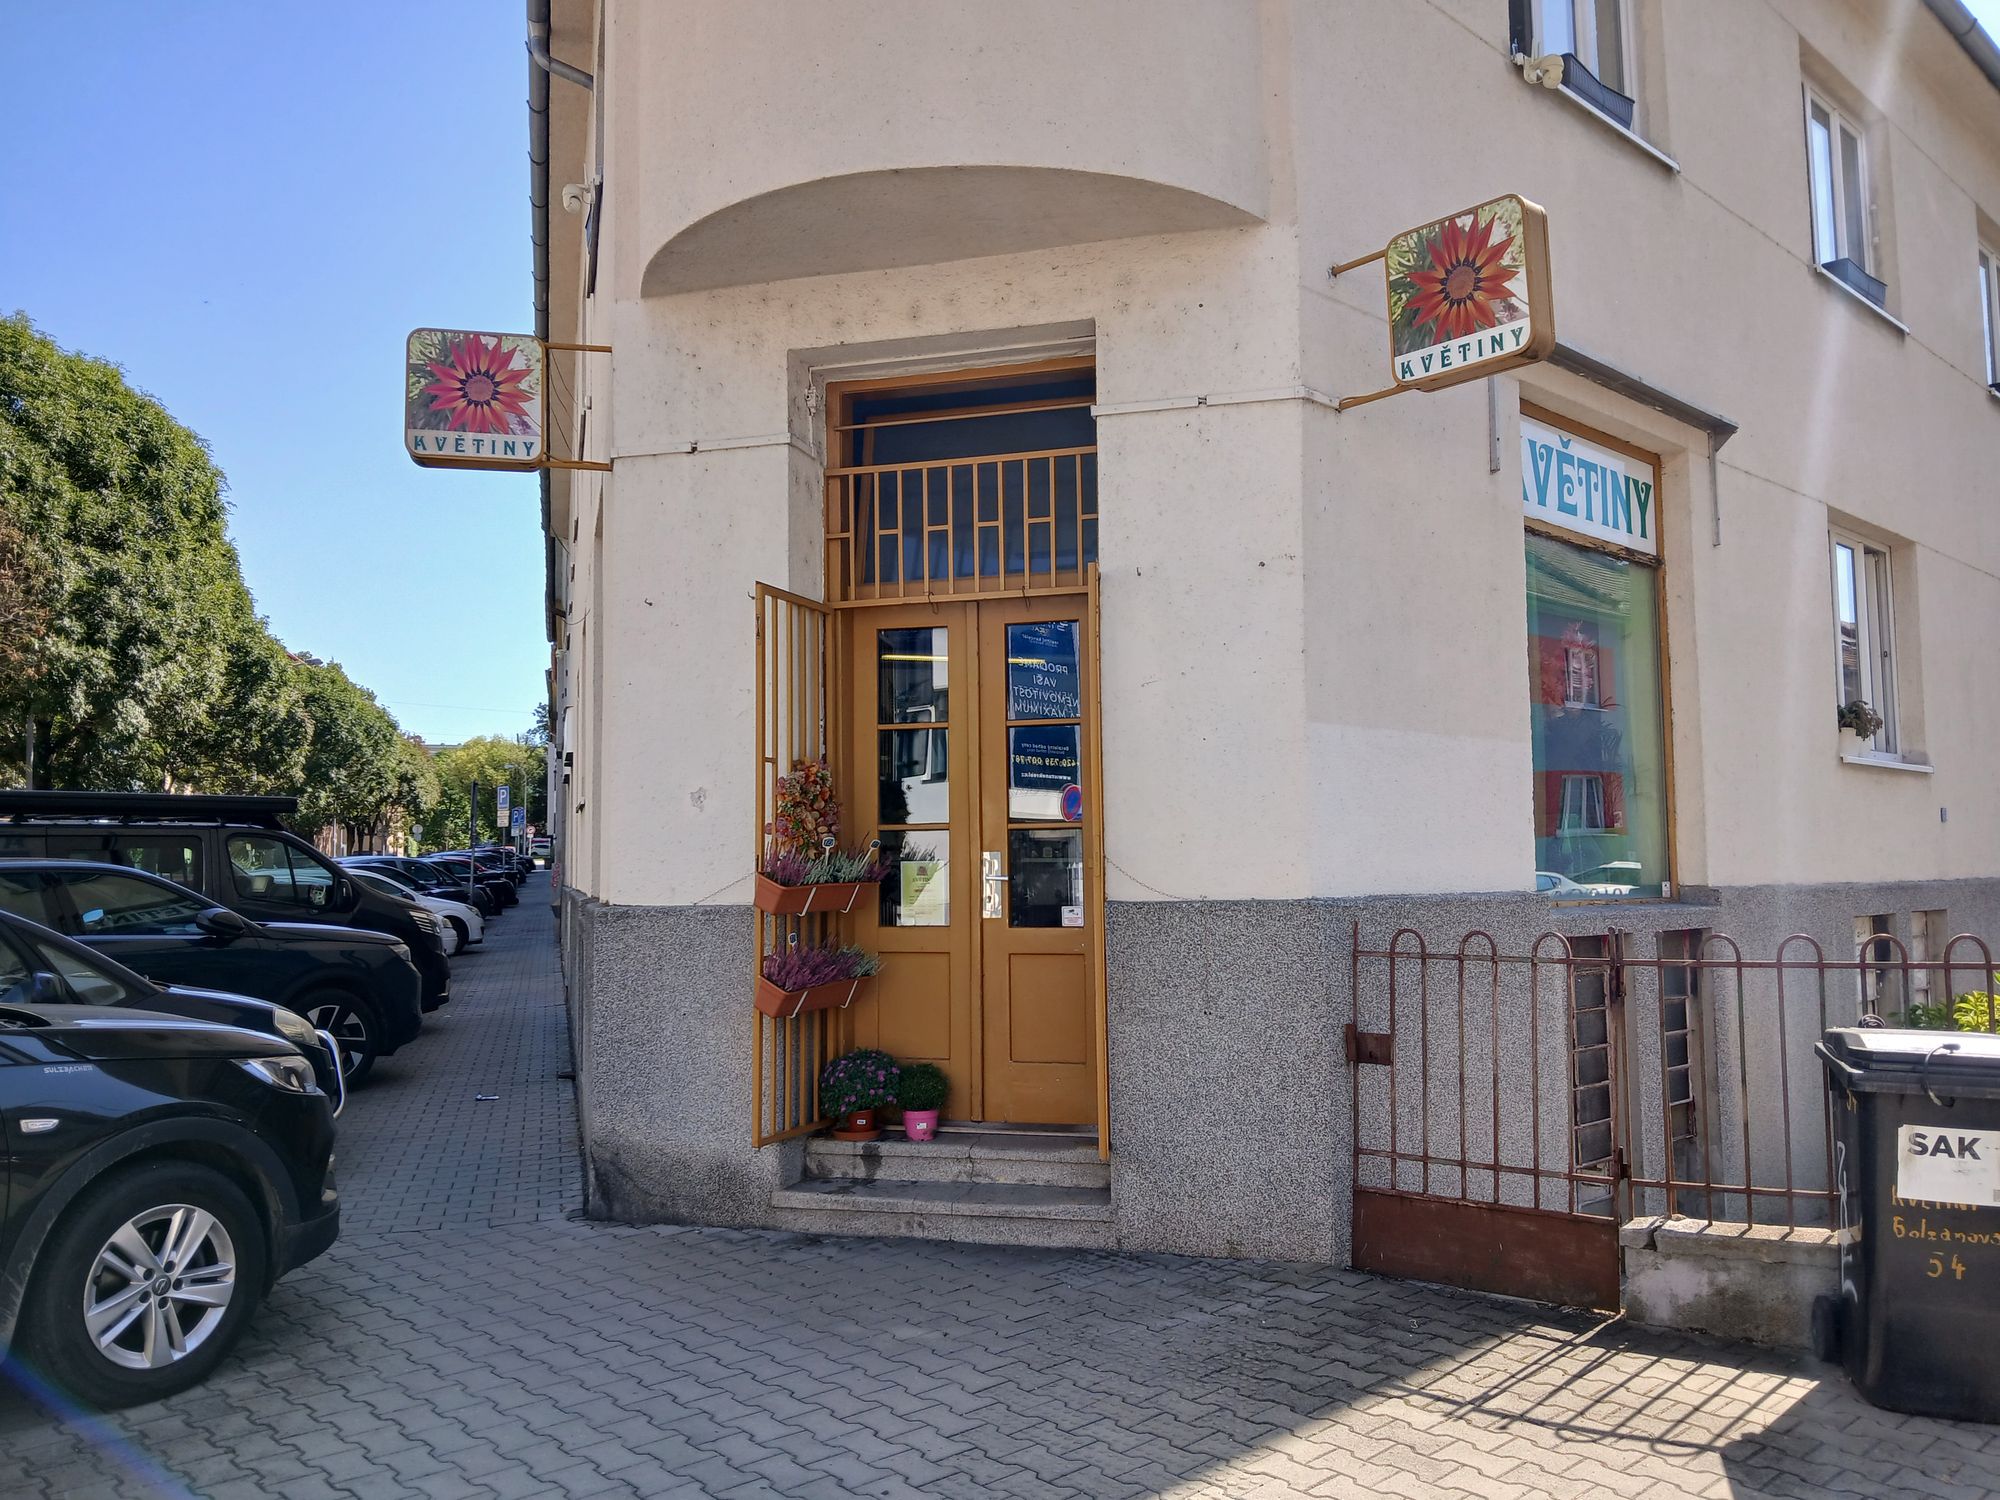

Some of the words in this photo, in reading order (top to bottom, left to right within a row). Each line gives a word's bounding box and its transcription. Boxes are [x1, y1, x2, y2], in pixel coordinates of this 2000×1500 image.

[1401, 326, 1524, 380] KVĚTINY
[414, 434, 534, 457] KVĚTINY
[1521, 434, 1652, 539] VĚTINY
[500, 790, 506, 803] P
[1908, 1132, 1982, 1161] SAK
[1927, 1251, 1967, 1281] 54
